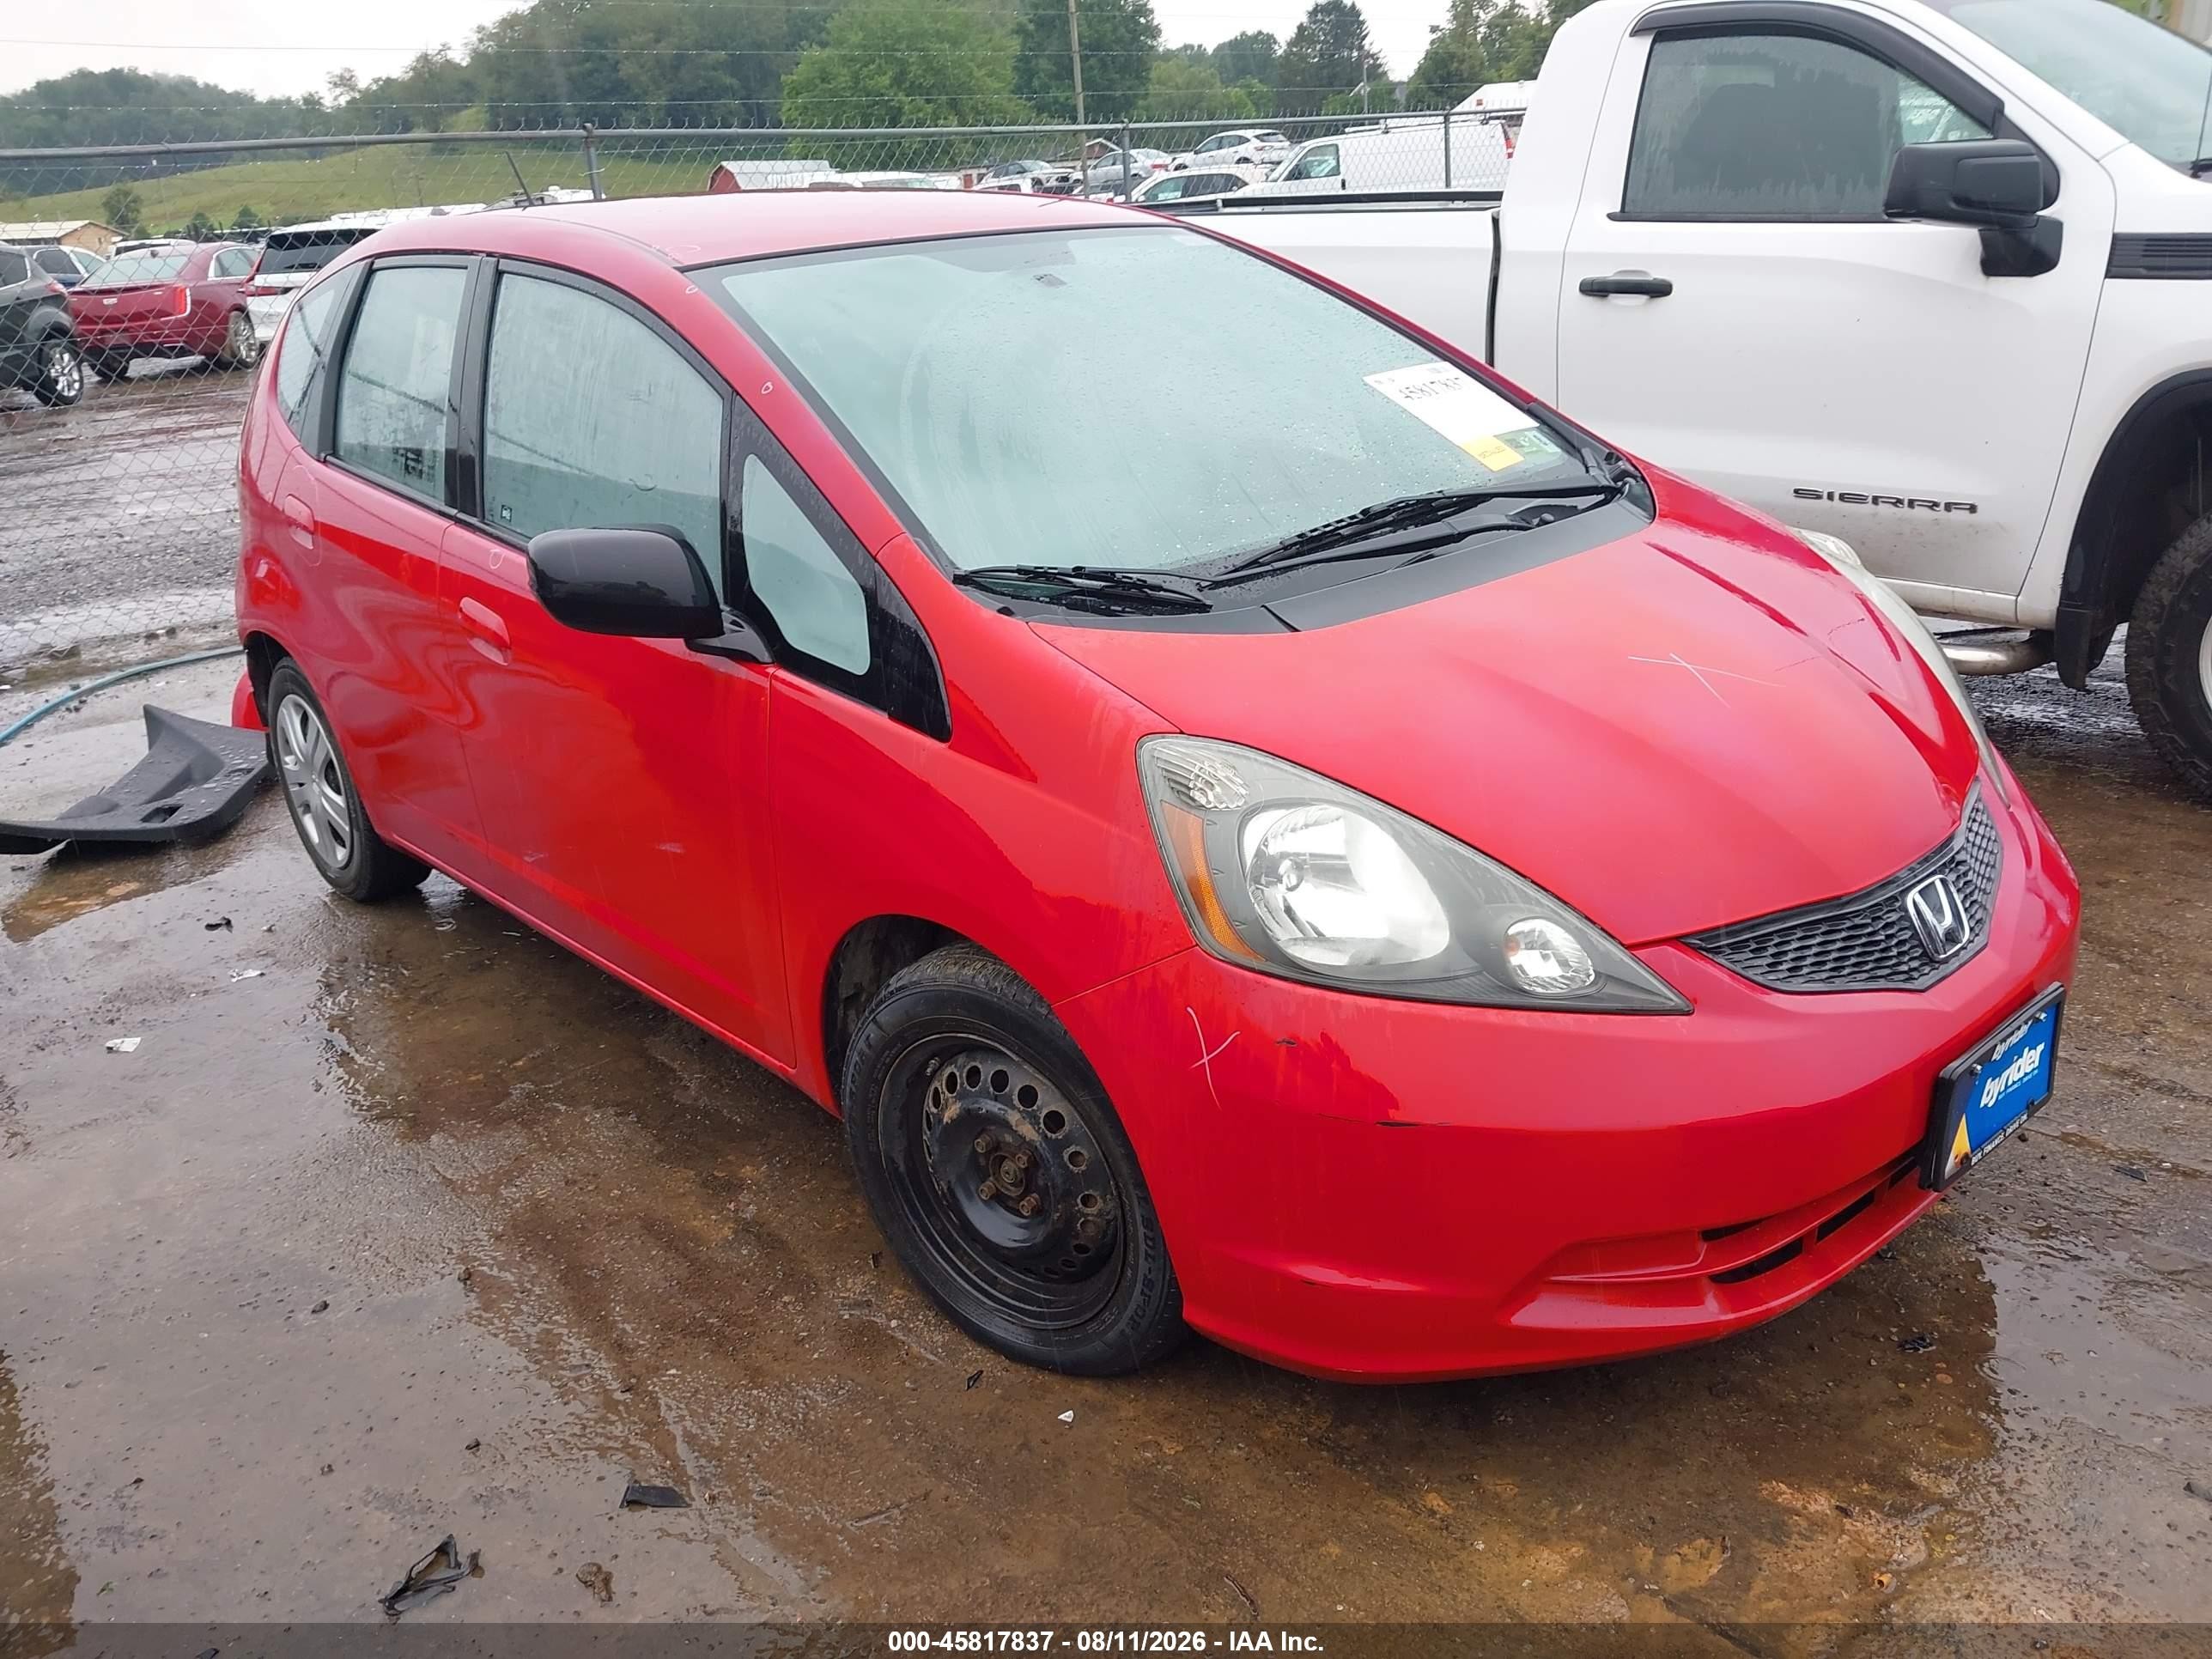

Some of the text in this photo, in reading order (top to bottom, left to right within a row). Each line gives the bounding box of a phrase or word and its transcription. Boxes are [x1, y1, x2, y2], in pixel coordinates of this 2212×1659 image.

[1792, 486, 1978, 514] SIERRA
[1990, 1018, 2033, 1061] byrider
[1979, 1041, 2045, 1109] byrider
